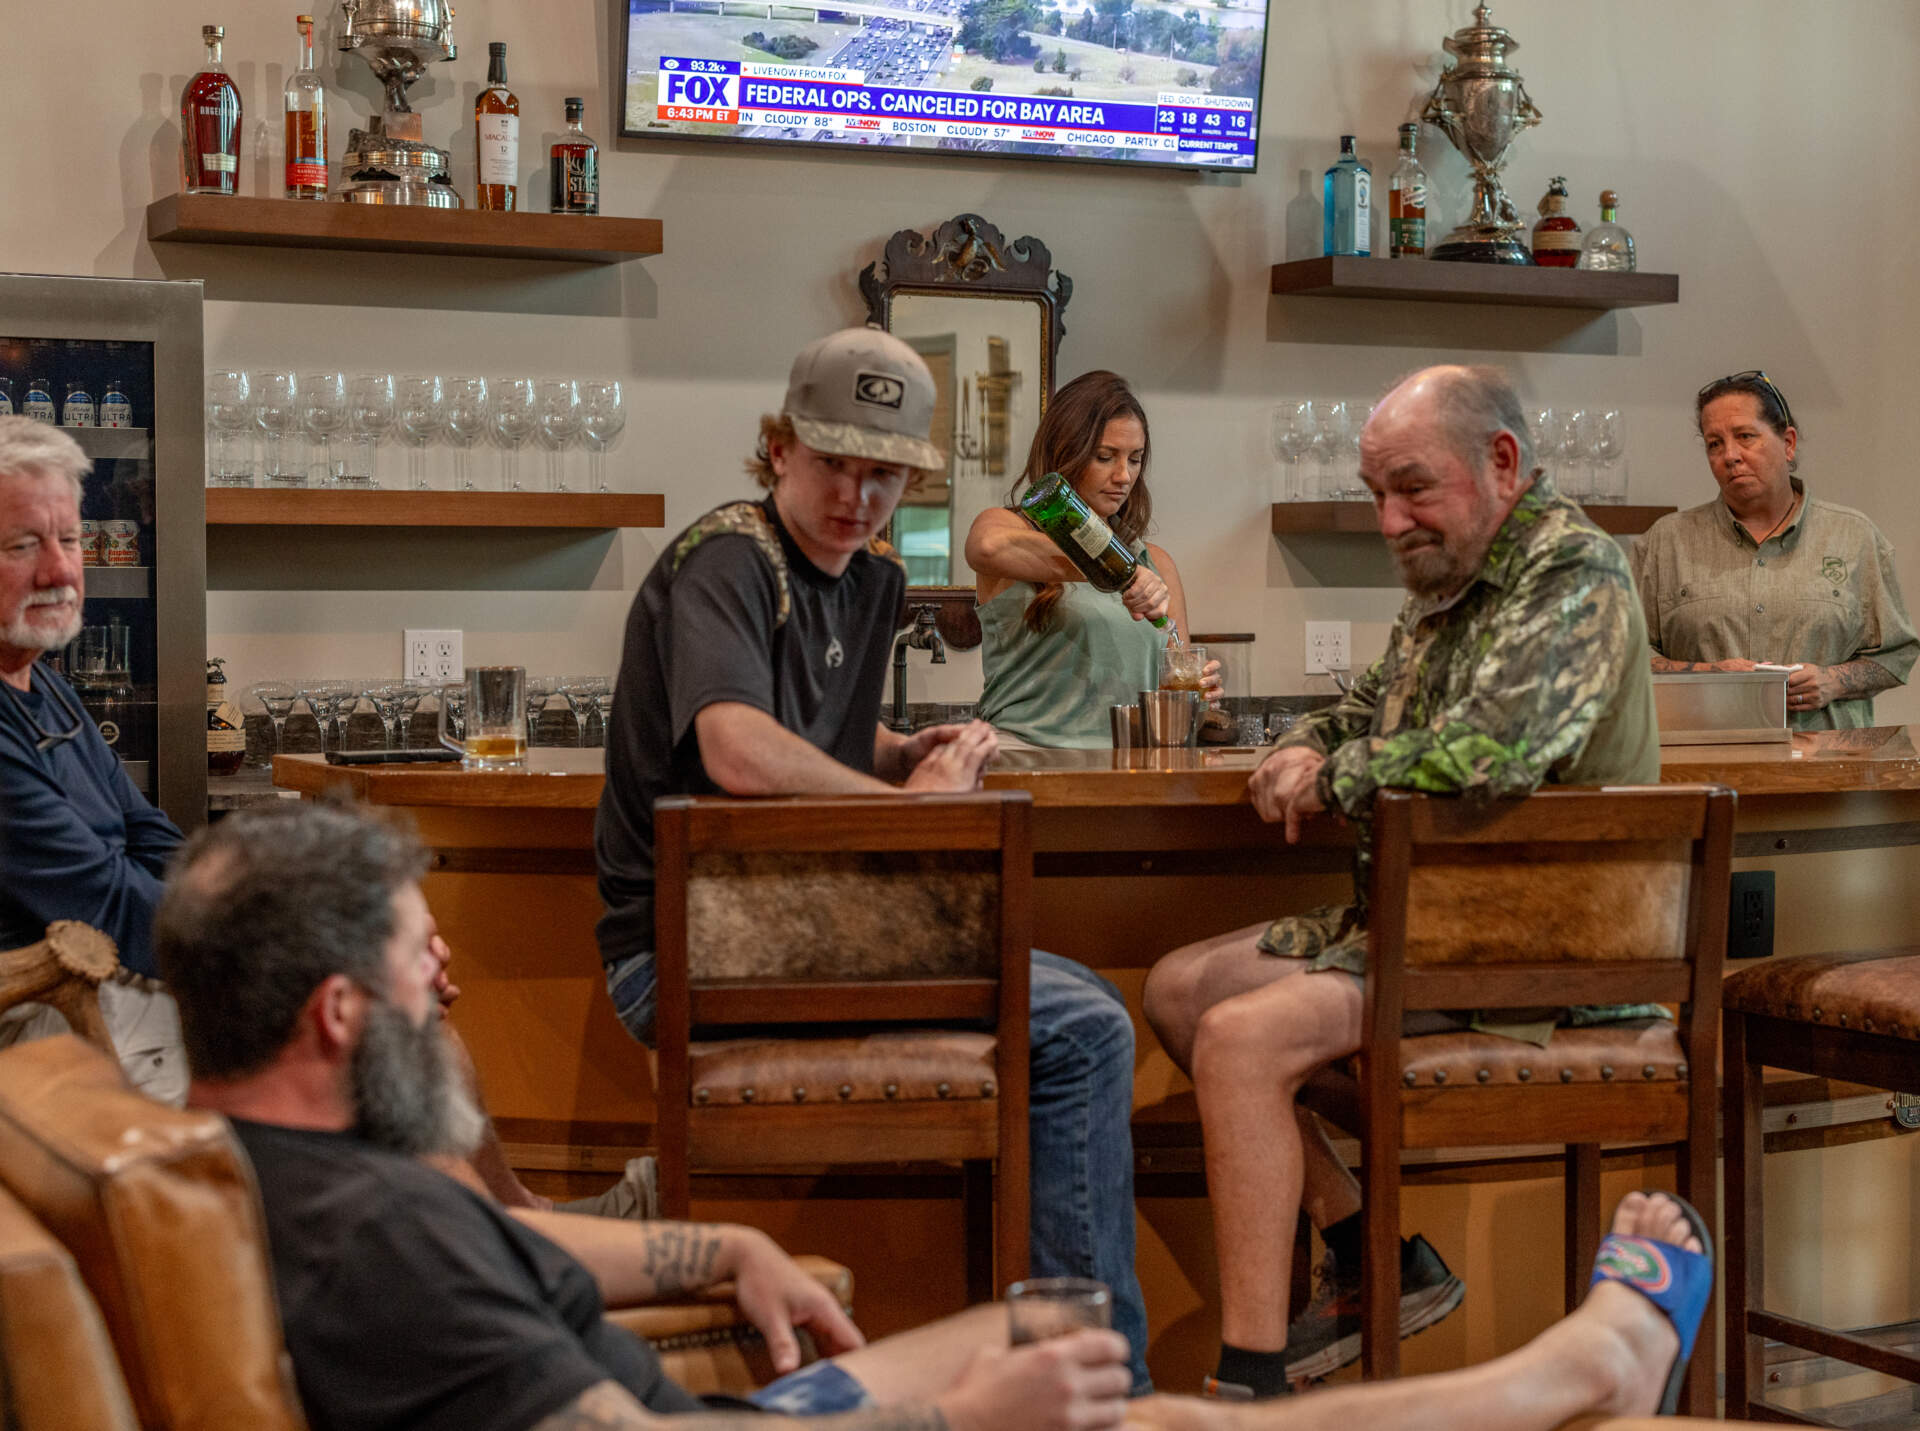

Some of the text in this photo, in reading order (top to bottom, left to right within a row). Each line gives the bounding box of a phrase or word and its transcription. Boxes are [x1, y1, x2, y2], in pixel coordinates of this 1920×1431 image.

[690, 59, 726, 73] 93.2k+
[753, 66, 847, 80] LIVENOW FROM FOX
[668, 74, 730, 107] FOX
[746, 84, 1104, 125] FEDERAL OPS. CANCELED FOR BAY AREA
[1160, 95, 1251, 108] FED GOVT SHUTDOWN
[667, 107, 730, 121] 6:43 PM ET
[1159, 110, 1246, 128] 23 18 43 16
[764, 113, 807, 126] CLOUDY
[814, 117, 832, 127] 88°
[893, 122, 936, 133] BOSTON
[947, 126, 988, 136] CLOUDY
[994, 128, 1010, 137] 57°
[1067, 133, 1114, 144] CHICAGO
[1125, 137, 1158, 147] PARTLY
[1164, 139, 1174, 148] CL
[1180, 140, 1238, 151] CURRENT TEMPS
